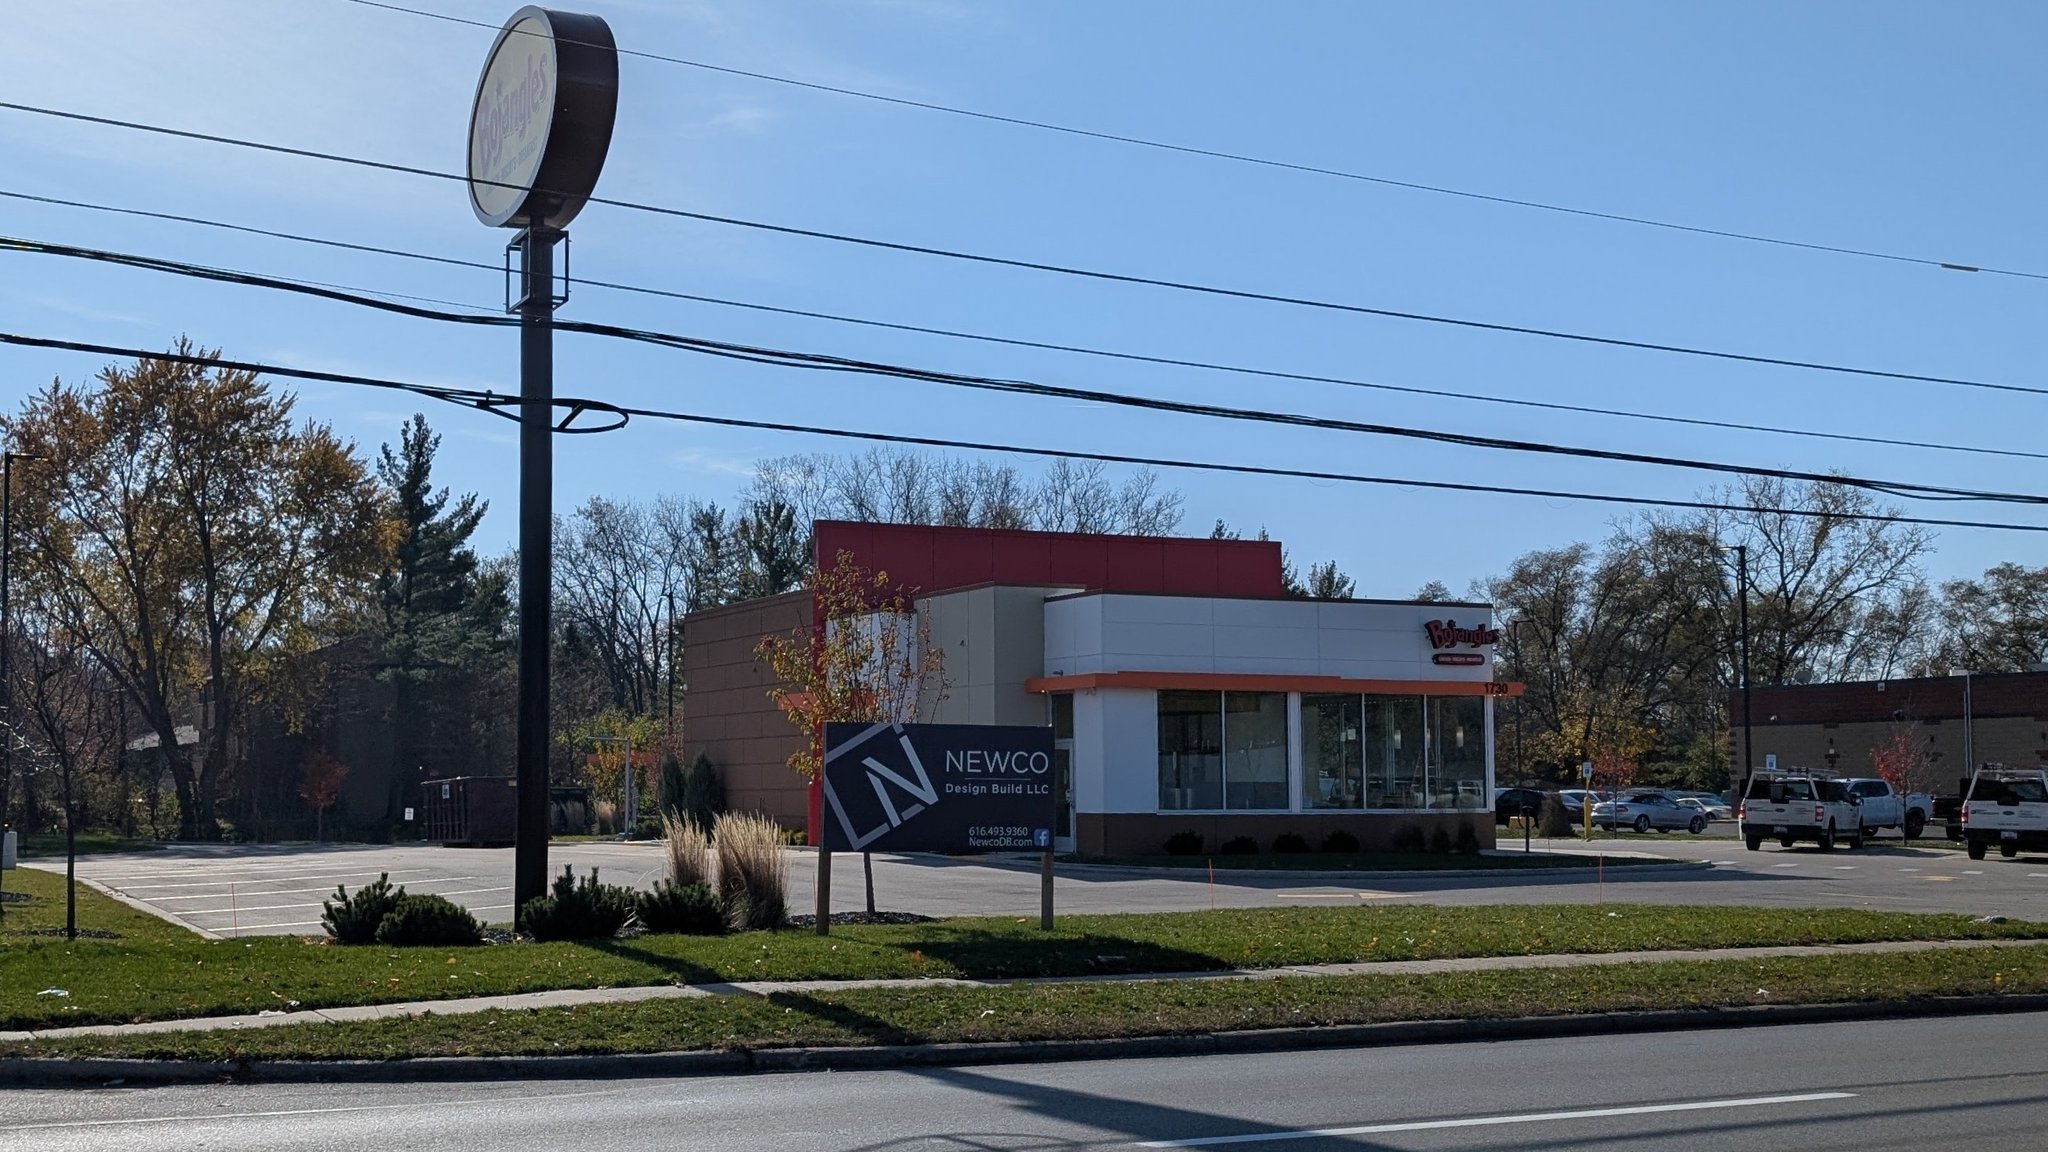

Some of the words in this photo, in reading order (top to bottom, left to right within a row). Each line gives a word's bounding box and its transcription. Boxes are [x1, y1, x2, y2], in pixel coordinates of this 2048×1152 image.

[475, 52, 548, 179] Bojangles
[1484, 683, 1508, 694] 1730
[945, 750, 1049, 774] NEWCO
[945, 783, 987, 796] Design
[992, 783, 1023, 794] Build
[1027, 784, 1049, 794] LLC
[968, 826, 1029, 836] 616.493.9360
[968, 837, 1033, 847] NewcoDB.com
